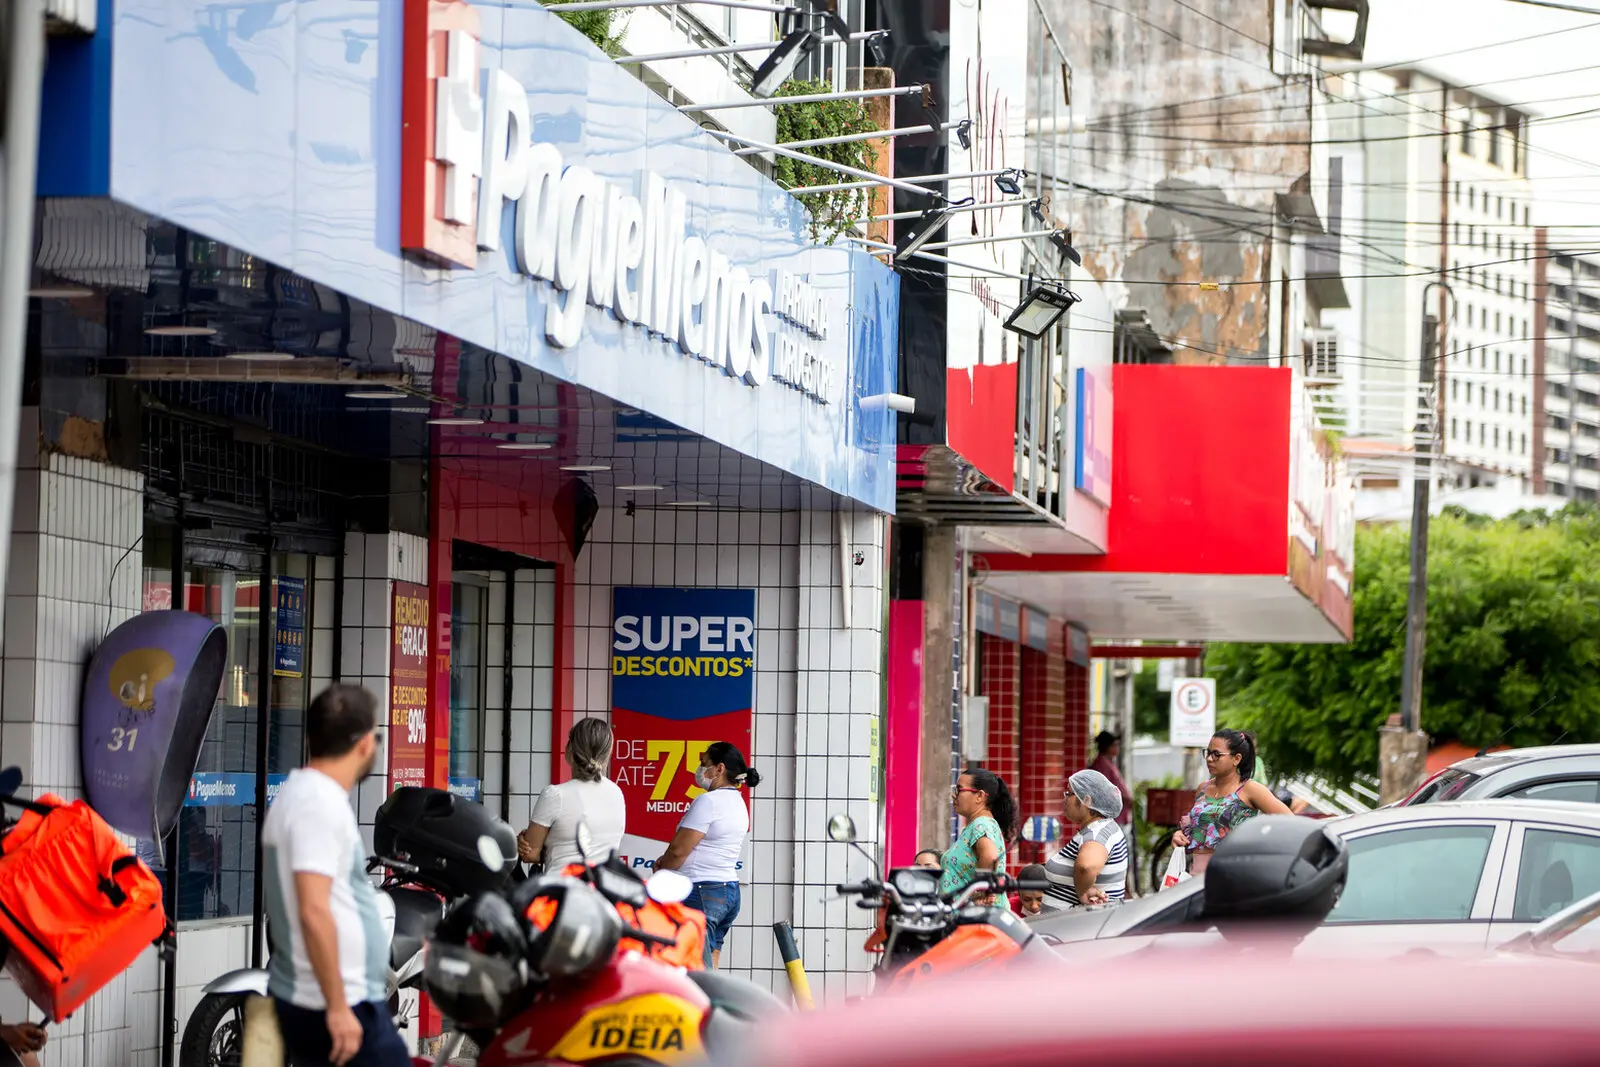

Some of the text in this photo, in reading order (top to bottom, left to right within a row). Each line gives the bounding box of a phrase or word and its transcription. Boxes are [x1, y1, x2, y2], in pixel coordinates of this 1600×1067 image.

[477, 68, 772, 387] PagueMenos
[395, 590, 429, 626] REMÉDIO
[402, 625, 428, 665] GRAÇA
[613, 615, 754, 653] SUPER
[1188, 690, 1199, 707] E
[107, 726, 139, 752] 31
[408, 708, 427, 744] 90%
[616, 740, 645, 760] DE
[615, 762, 656, 786] ATÉ
[195, 780, 237, 802] PagueMenos
[588, 1027, 685, 1052] IDEIA
